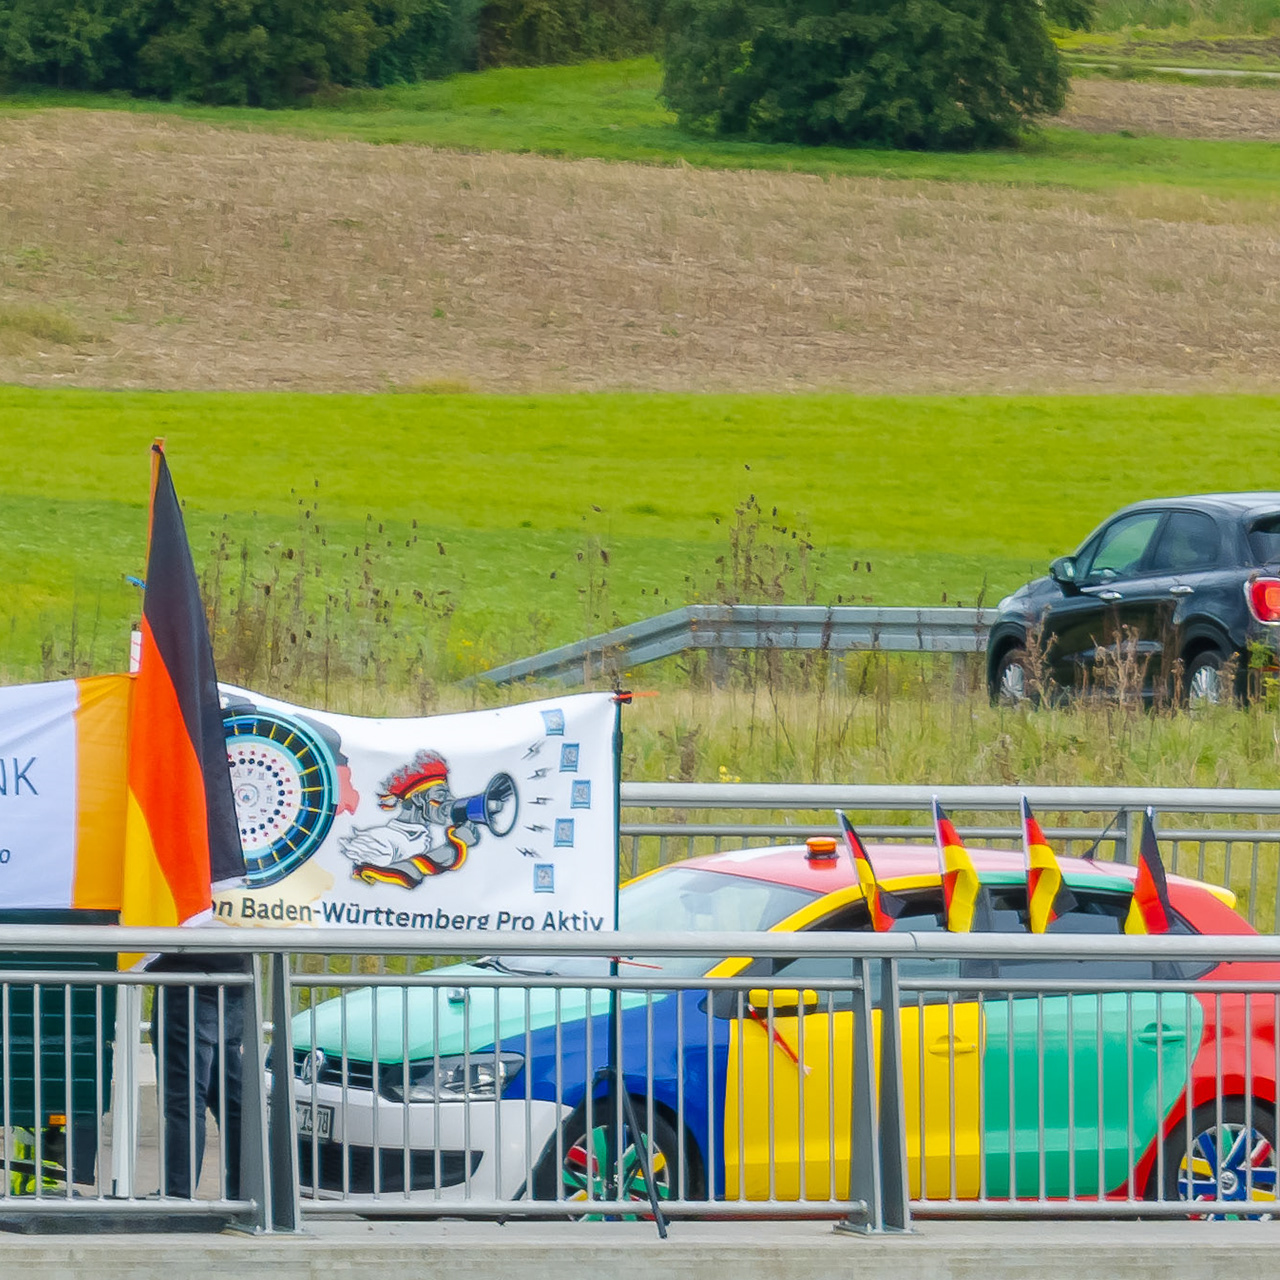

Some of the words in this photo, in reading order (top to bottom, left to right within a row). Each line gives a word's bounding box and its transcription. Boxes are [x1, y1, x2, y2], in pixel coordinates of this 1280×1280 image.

[240, 896, 490, 930] Baden-Württemberg
[496, 911, 535, 931] Pro
[541, 910, 604, 931] Aktiv
